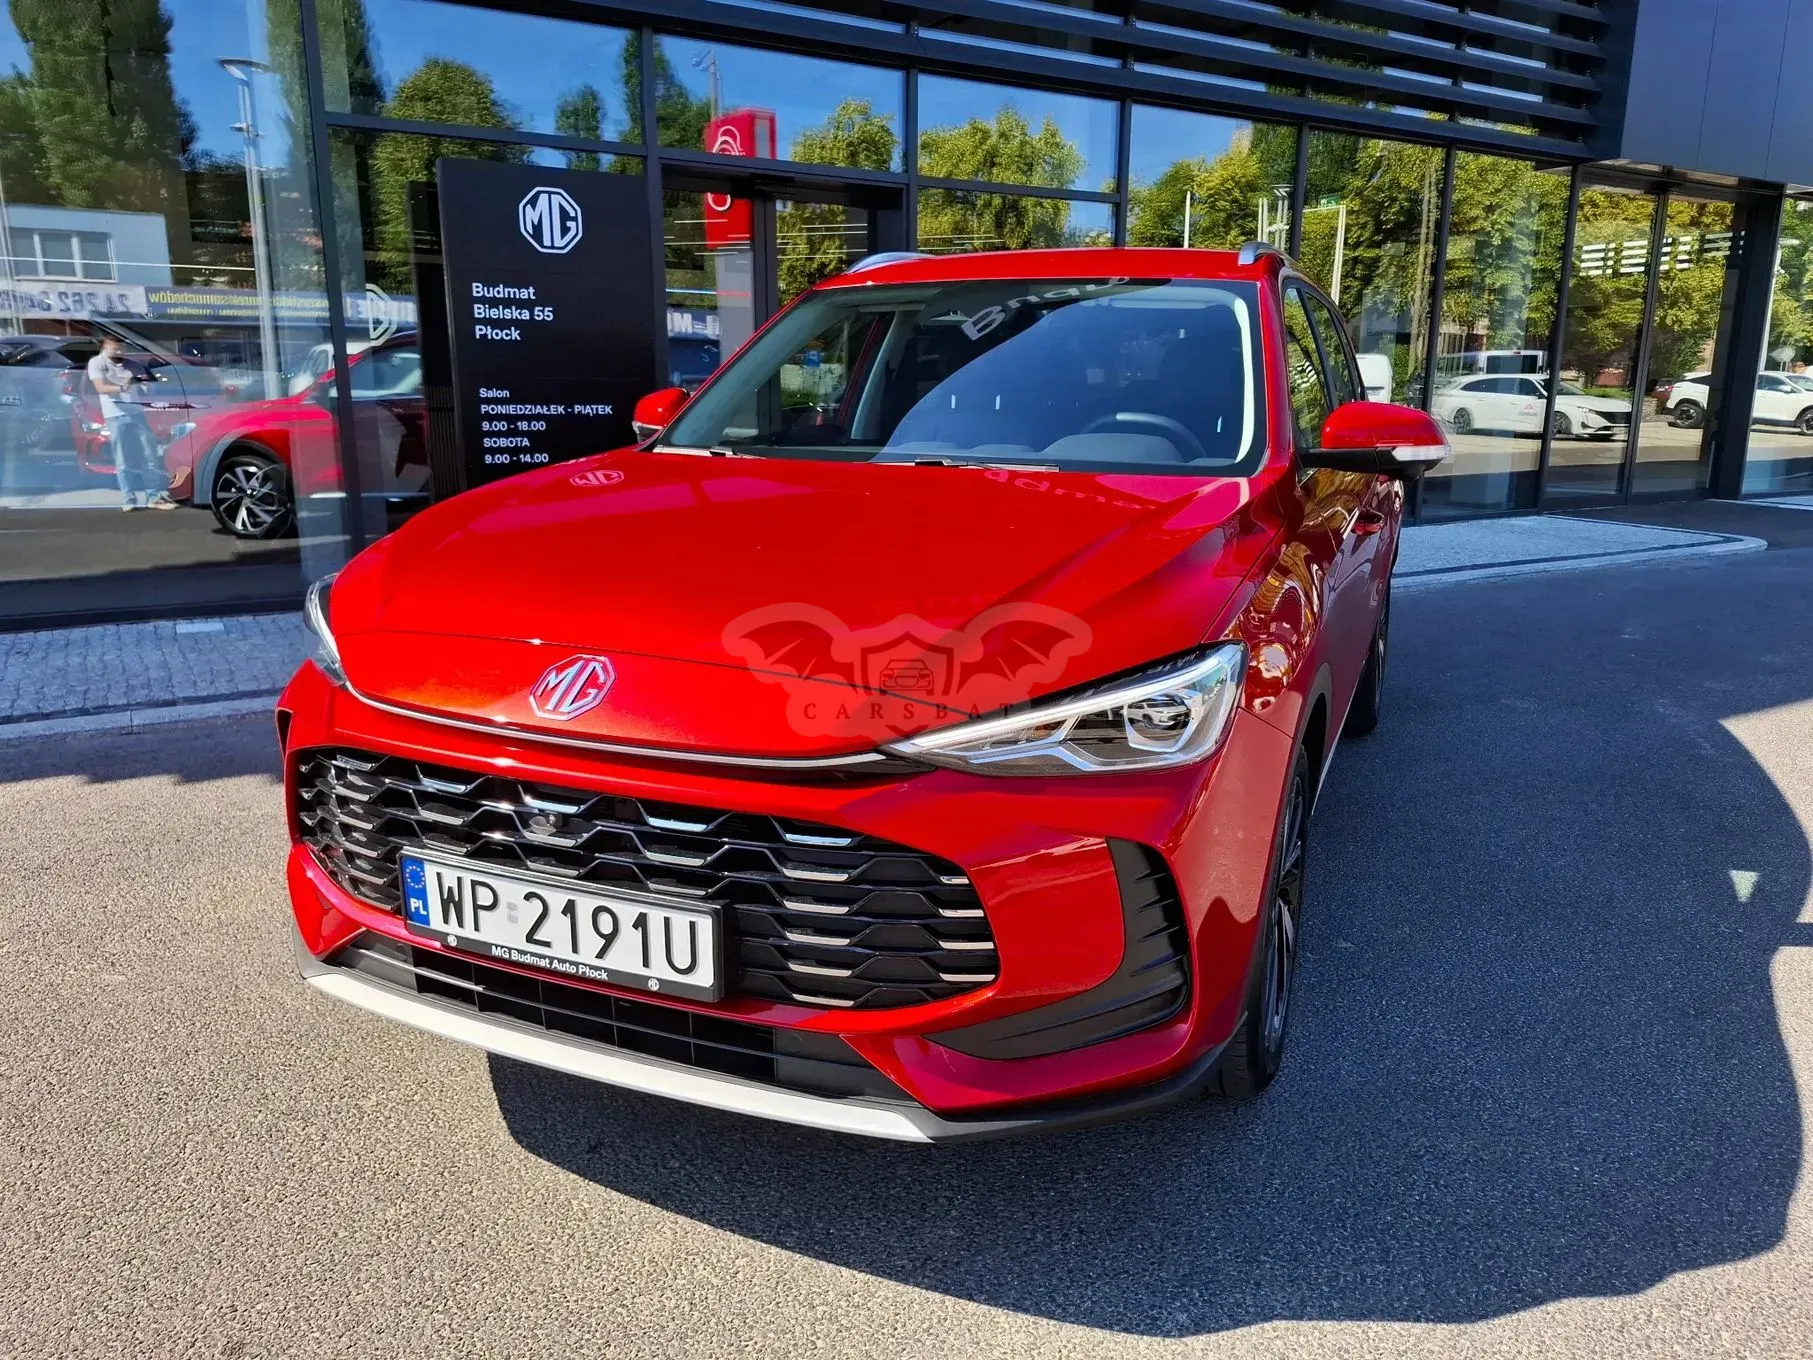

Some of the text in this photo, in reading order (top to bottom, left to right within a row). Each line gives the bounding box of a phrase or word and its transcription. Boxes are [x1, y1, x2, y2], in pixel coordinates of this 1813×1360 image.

[523, 191, 578, 249] MG
[472, 282, 536, 299] Budmat
[473, 304, 554, 321] Bielska 55
[475, 325, 521, 340] Płock
[479, 388, 510, 398] Salon
[481, 404, 565, 414] PONIEDZIAŁEK
[574, 405, 613, 416] PIĄTEK
[482, 421, 508, 431] 9.00
[516, 421, 546, 431] 18.00
[483, 437, 530, 448] SOBOTA
[484, 454, 510, 464] 9.00
[519, 453, 549, 463] 14.00
[538, 658, 608, 715] MG
[410, 897, 427, 916] PL
[435, 871, 698, 976] WP 2191U
[491, 945, 609, 980] MG Budmat Auto Płock
